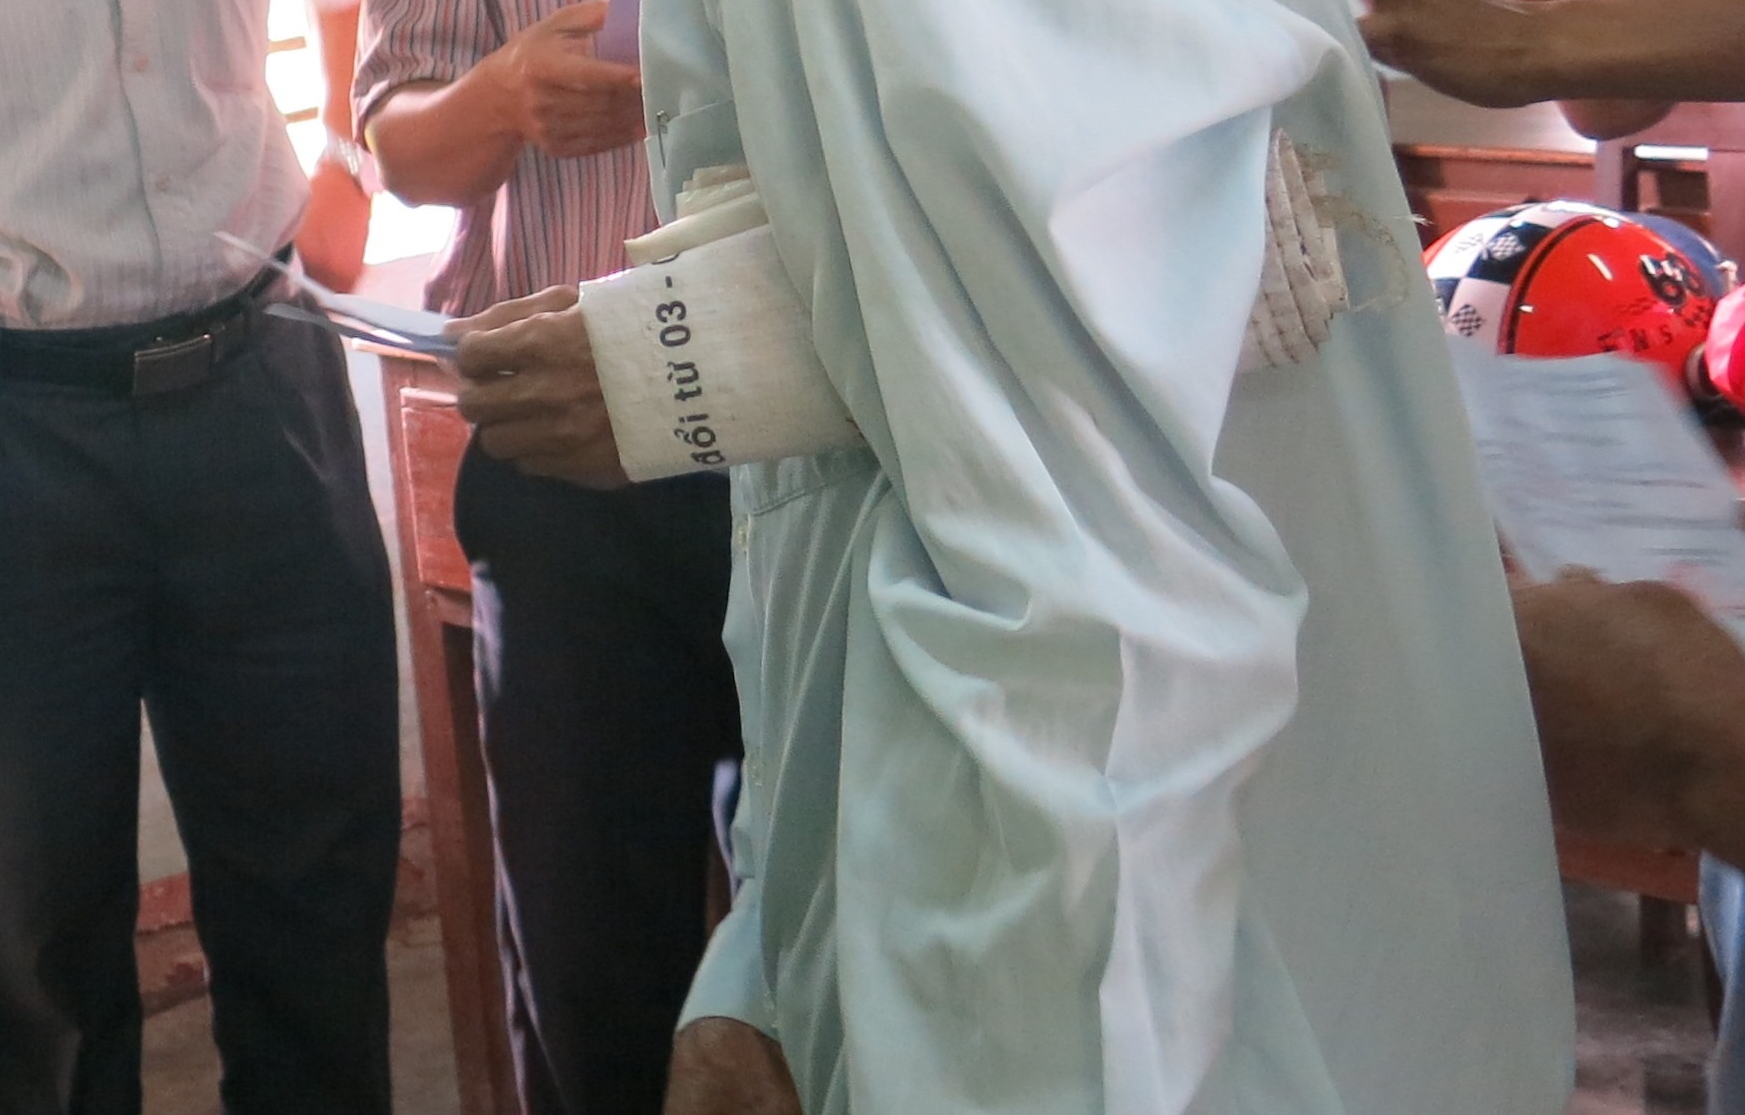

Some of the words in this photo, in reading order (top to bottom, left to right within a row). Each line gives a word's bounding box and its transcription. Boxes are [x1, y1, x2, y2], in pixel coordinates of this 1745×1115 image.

[655, 300, 691, 347] 03
[666, 361, 702, 402] từ
[673, 413, 726, 465] đổi
